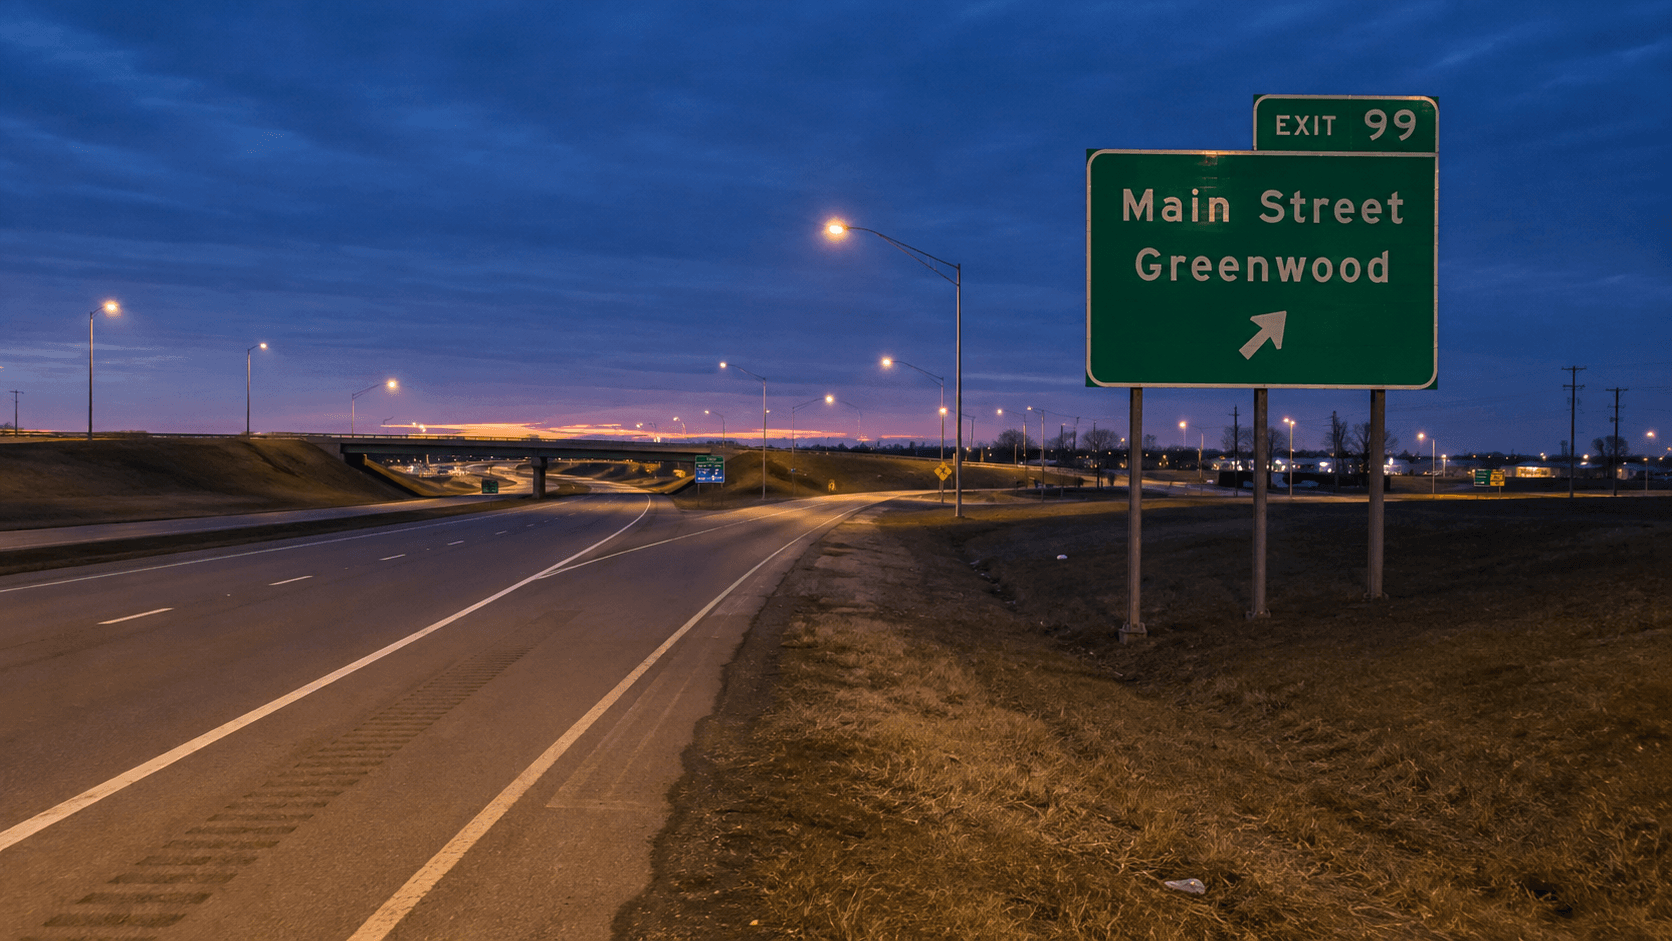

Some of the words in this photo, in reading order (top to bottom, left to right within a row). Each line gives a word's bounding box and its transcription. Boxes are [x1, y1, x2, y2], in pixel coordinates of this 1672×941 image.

[1276, 115, 1336, 136] EXIT
[1364, 109, 1417, 141] 99
[1122, 188, 1230, 223] Main
[1259, 189, 1404, 224] Street
[1135, 247, 1390, 283] Greenwood
